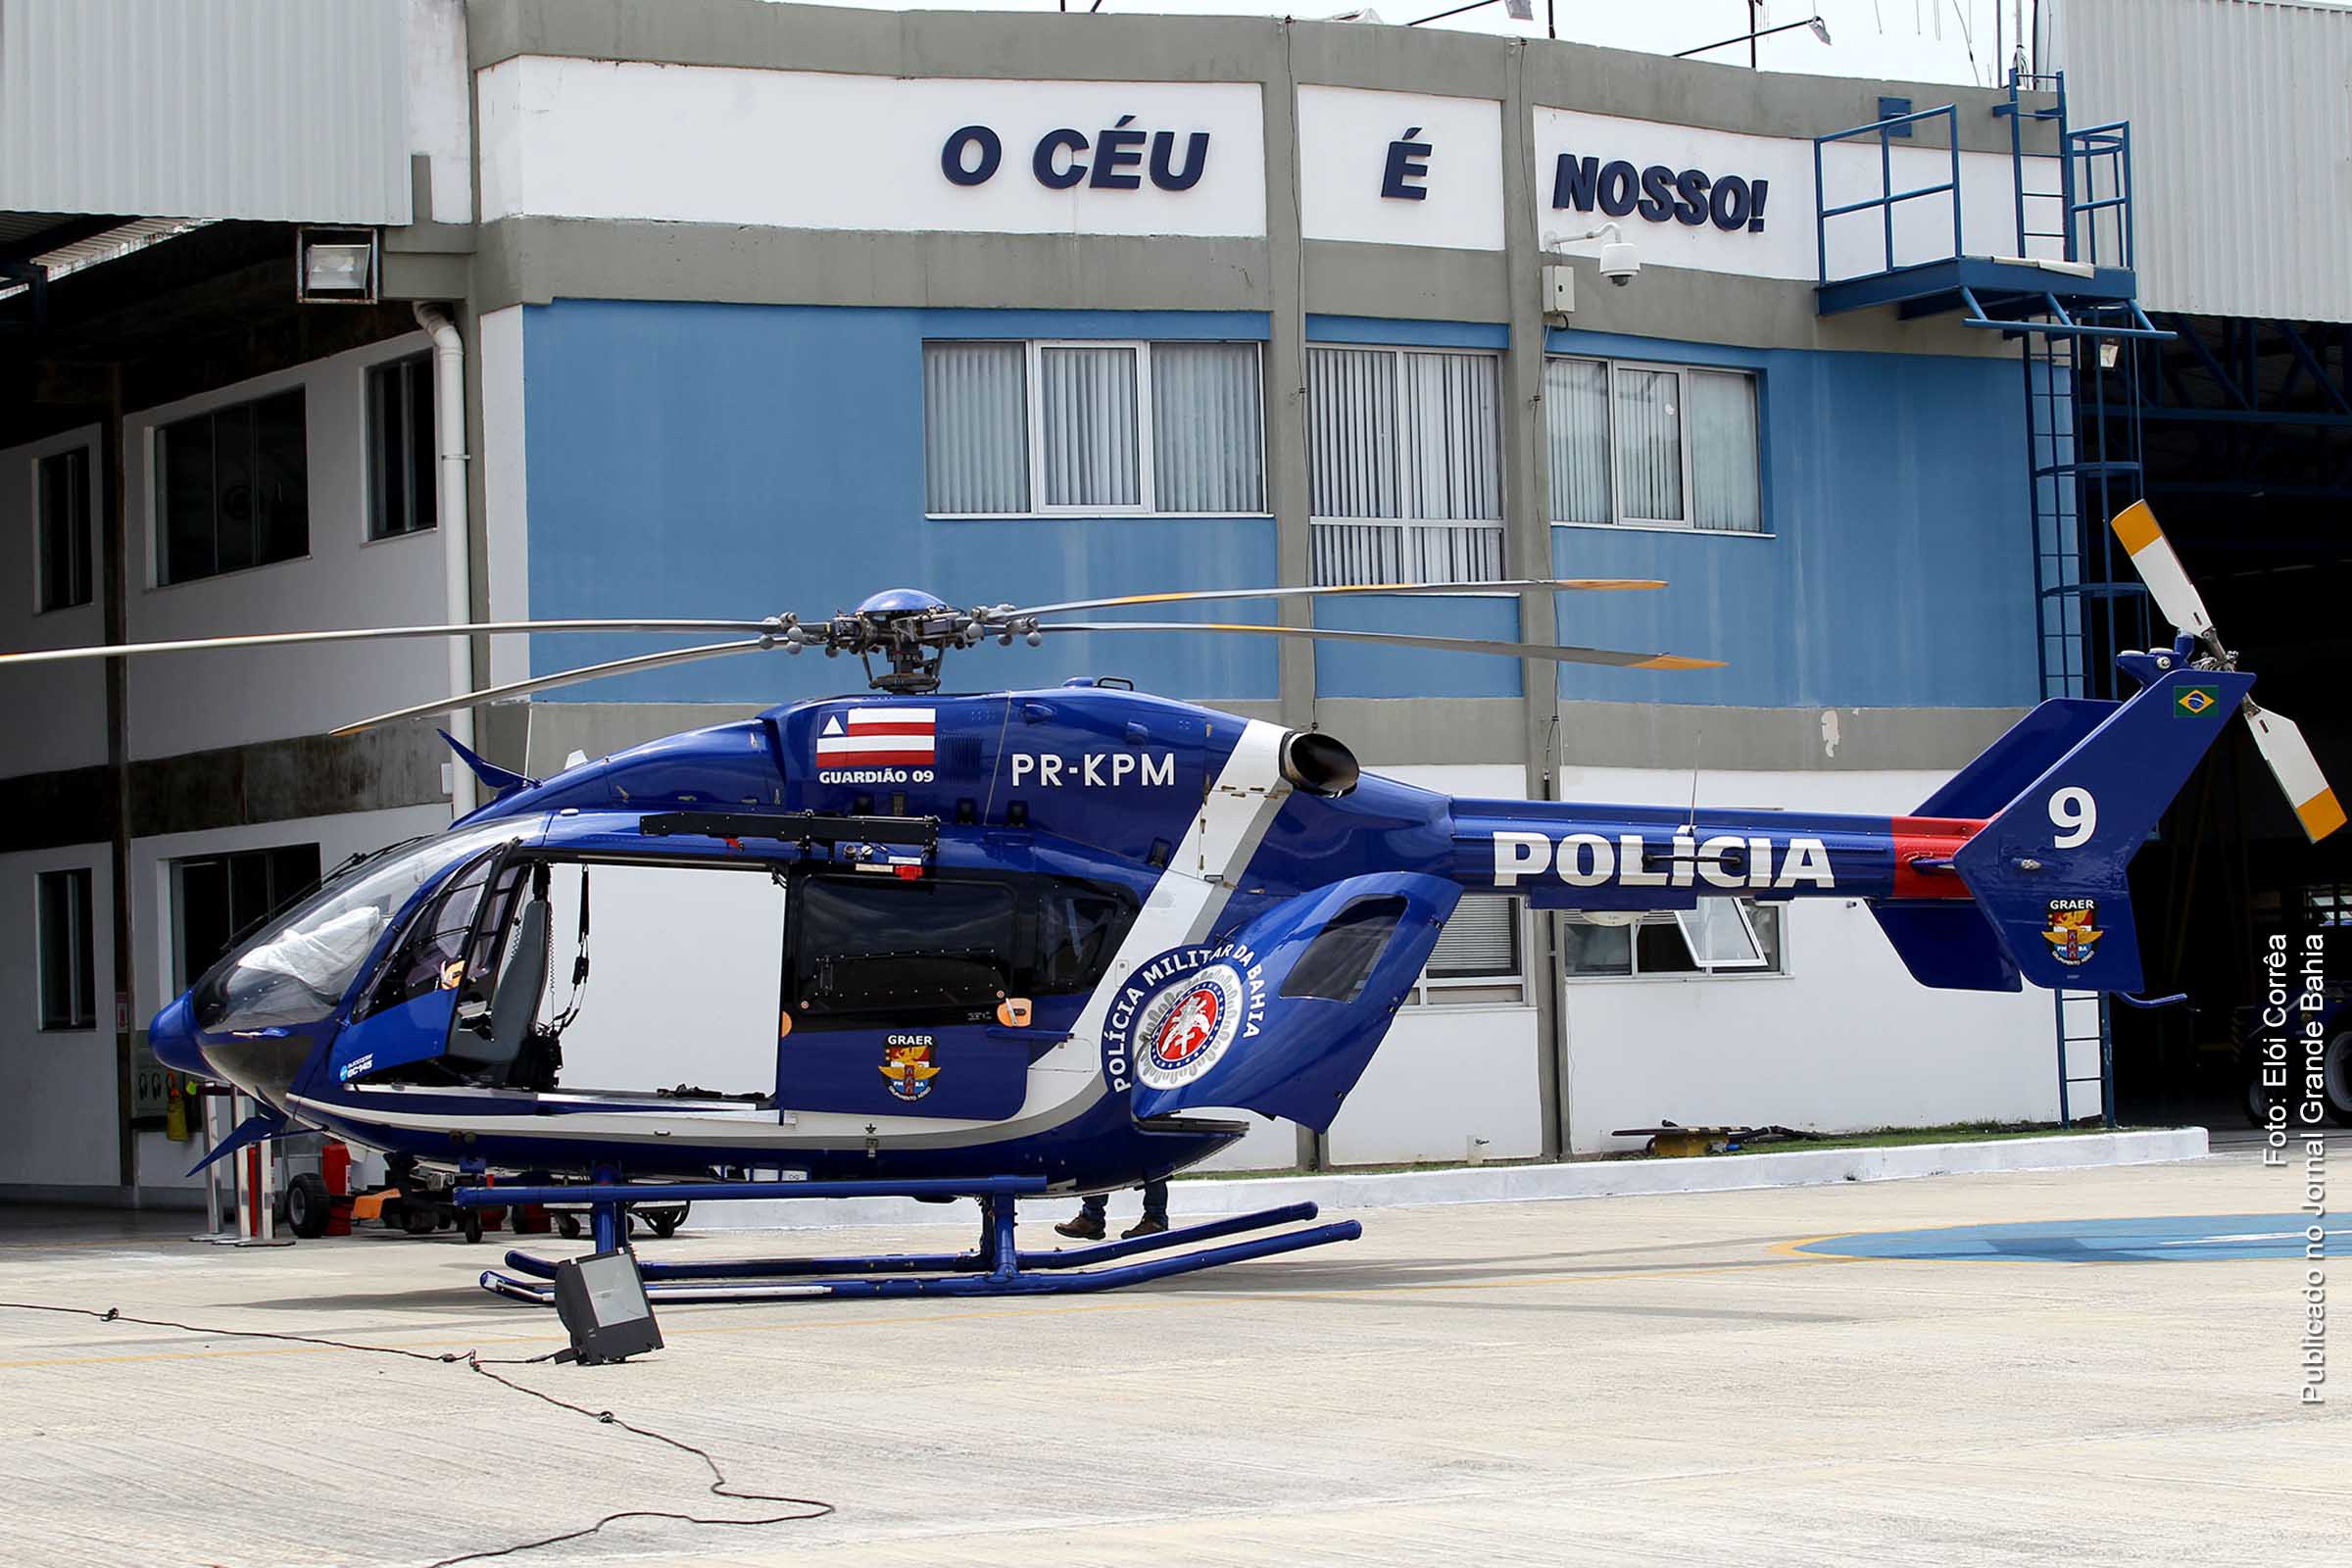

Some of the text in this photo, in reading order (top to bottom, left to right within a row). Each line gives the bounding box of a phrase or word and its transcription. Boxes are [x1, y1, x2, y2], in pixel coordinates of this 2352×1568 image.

[941, 114, 1770, 234] O CÉU É NOSSO!
[818, 767, 935, 784] GUARDIÃO 09
[1011, 753, 1175, 787] PR-KPM
[2048, 786, 2097, 849] 9
[1493, 824, 1835, 888] POLÍCIA
[2049, 899, 2094, 909] GRAER
[887, 1035, 933, 1045] GRAER
[1103, 943, 1267, 1093] POLÍCIA MILITAR DA BAHIA
